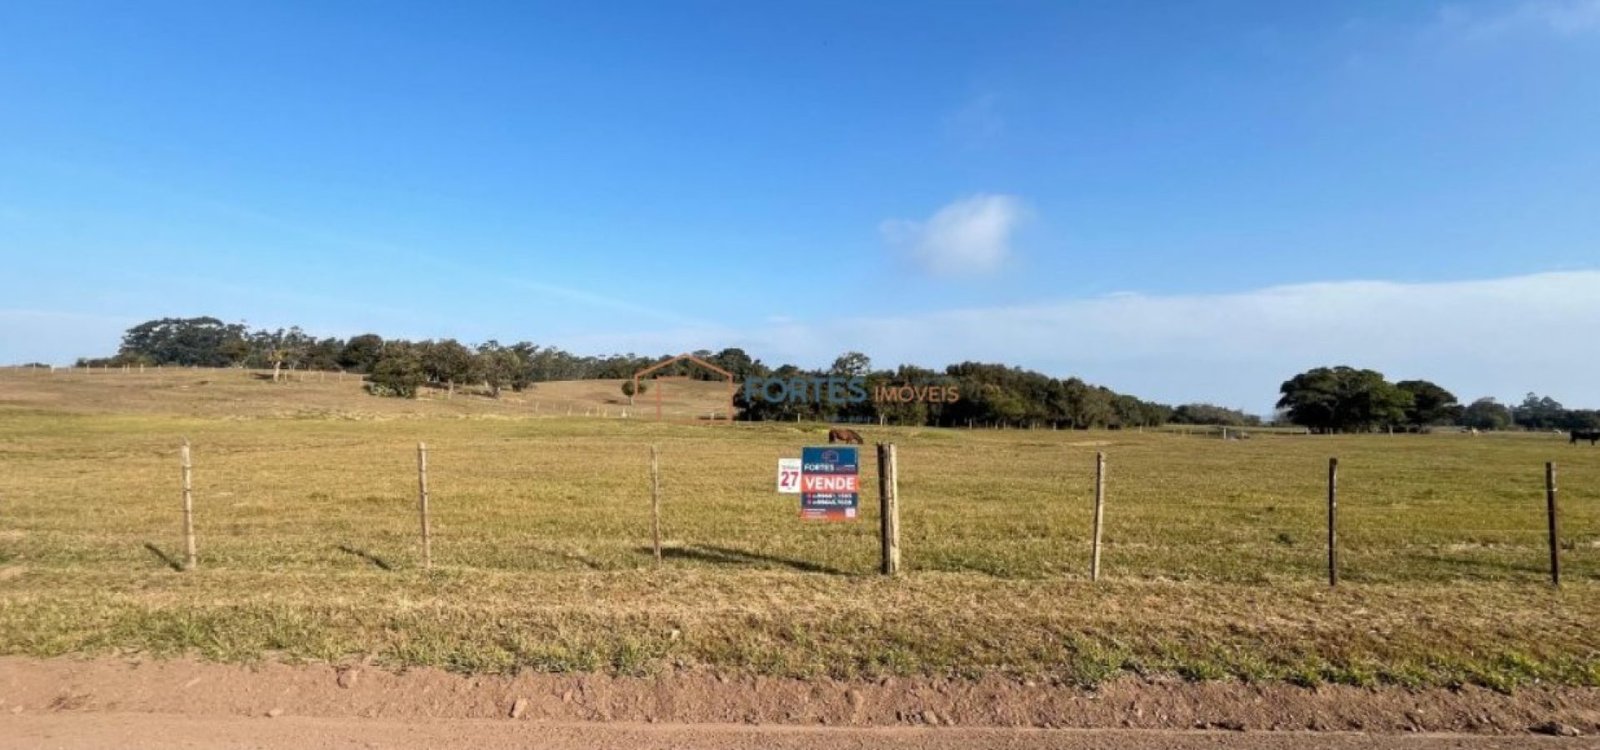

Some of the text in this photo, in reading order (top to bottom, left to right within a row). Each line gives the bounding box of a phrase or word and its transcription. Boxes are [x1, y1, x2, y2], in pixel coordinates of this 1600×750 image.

[804, 463, 834, 471] FORTES
[781, 471, 799, 487] 27
[805, 477, 855, 490] VENDE
